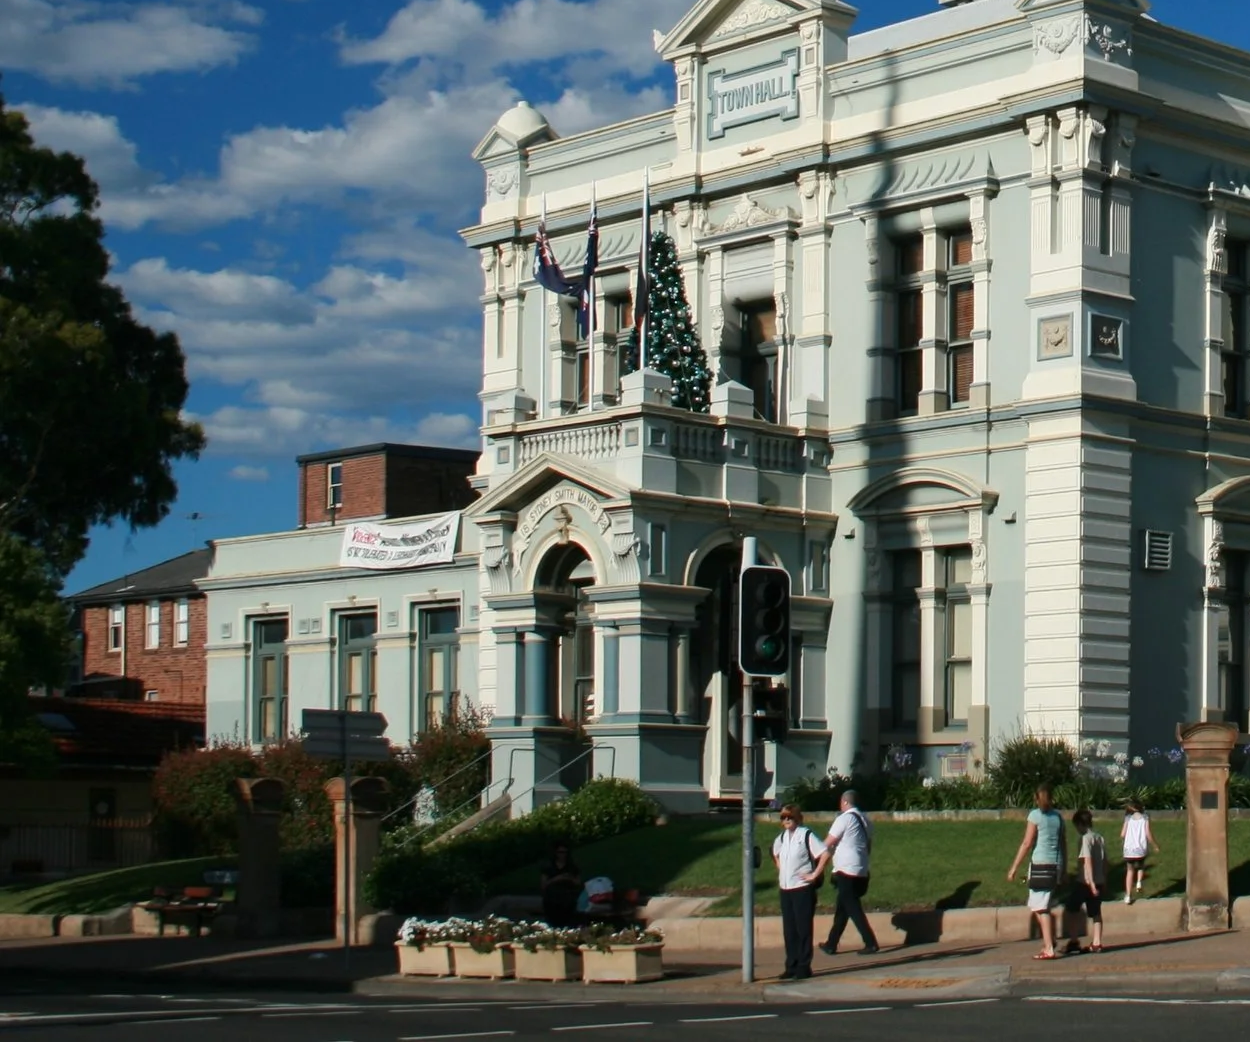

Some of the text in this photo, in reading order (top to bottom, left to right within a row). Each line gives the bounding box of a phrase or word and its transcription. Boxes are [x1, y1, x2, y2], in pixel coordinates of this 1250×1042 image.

[718, 83, 753, 114] TOWN
[529, 493, 552, 521] SYDNEY
[554, 488, 575, 501] SMITH
